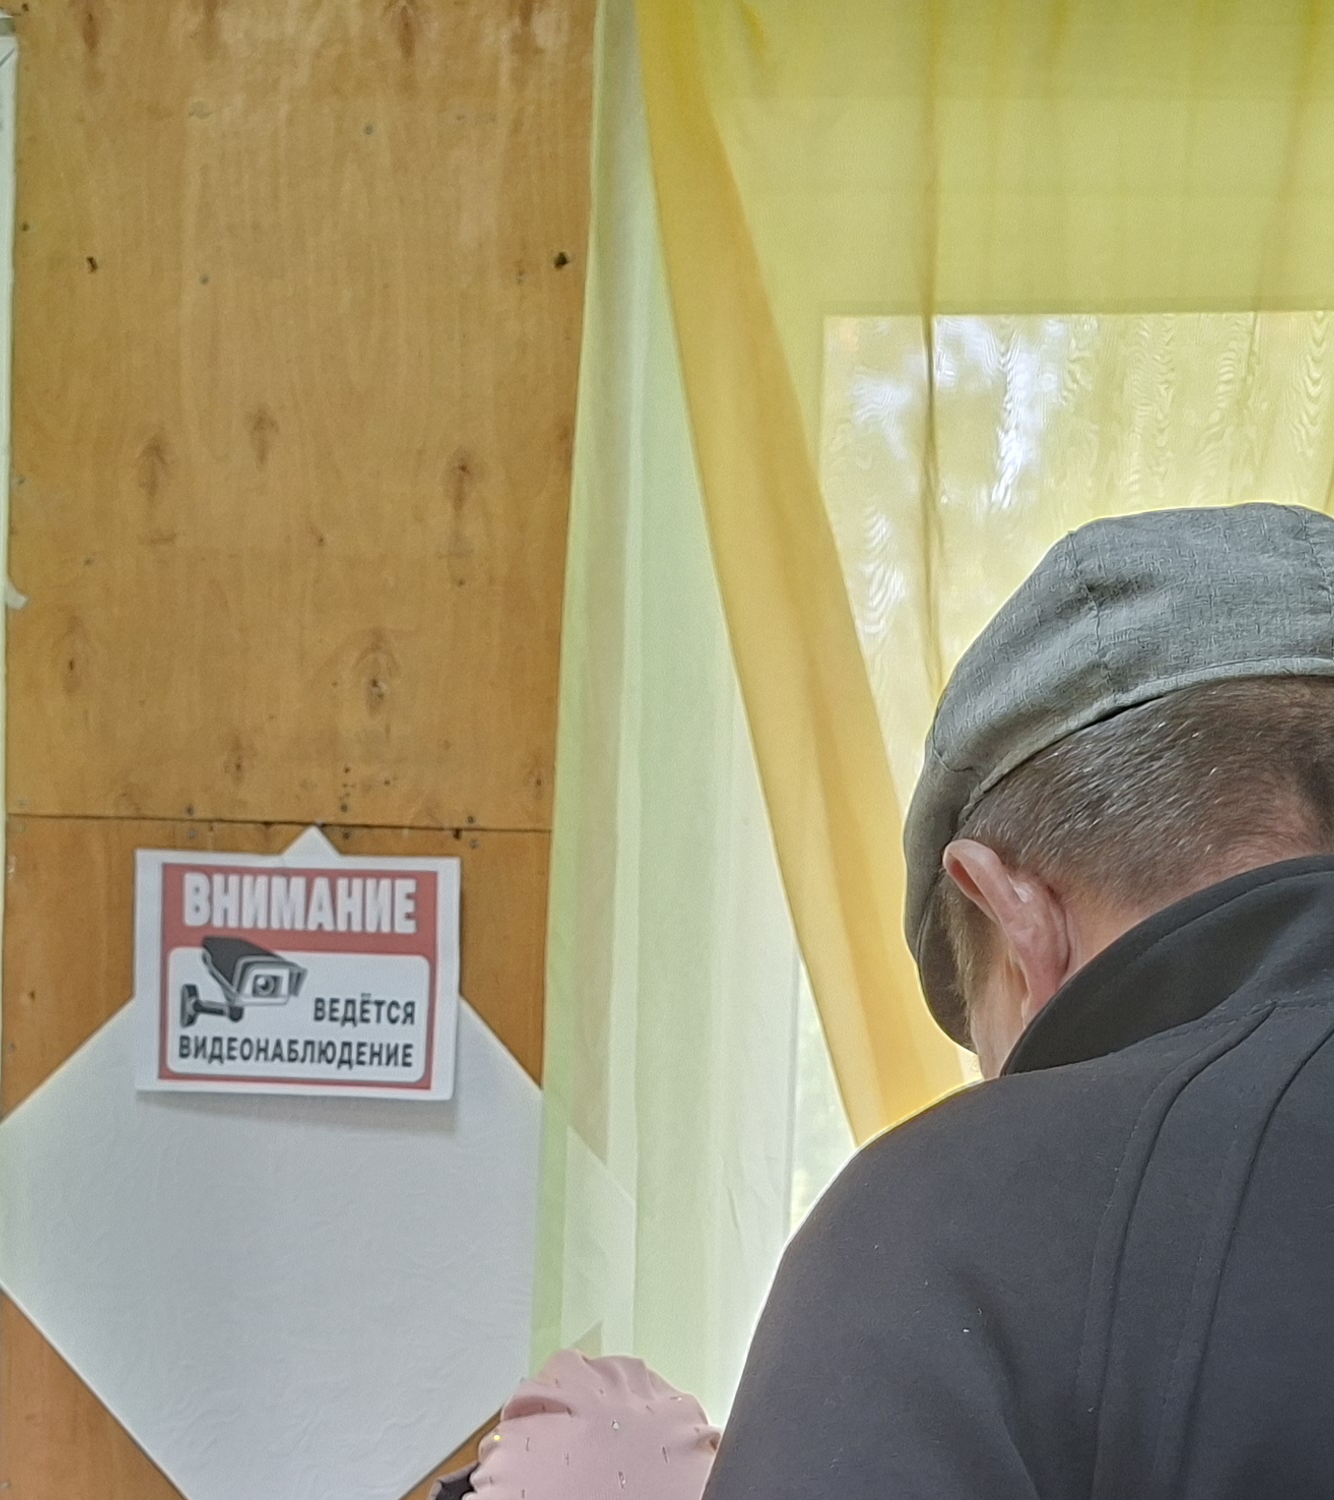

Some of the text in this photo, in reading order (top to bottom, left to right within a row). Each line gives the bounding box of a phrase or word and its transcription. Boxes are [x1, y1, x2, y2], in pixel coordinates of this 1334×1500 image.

[182, 871, 417, 935] ВНИМАНИЕ
[313, 993, 416, 1028] ВЕДЁТСЯ
[178, 1035, 413, 1069] ВИДЕОНАБЛЮДЕНИЕ
